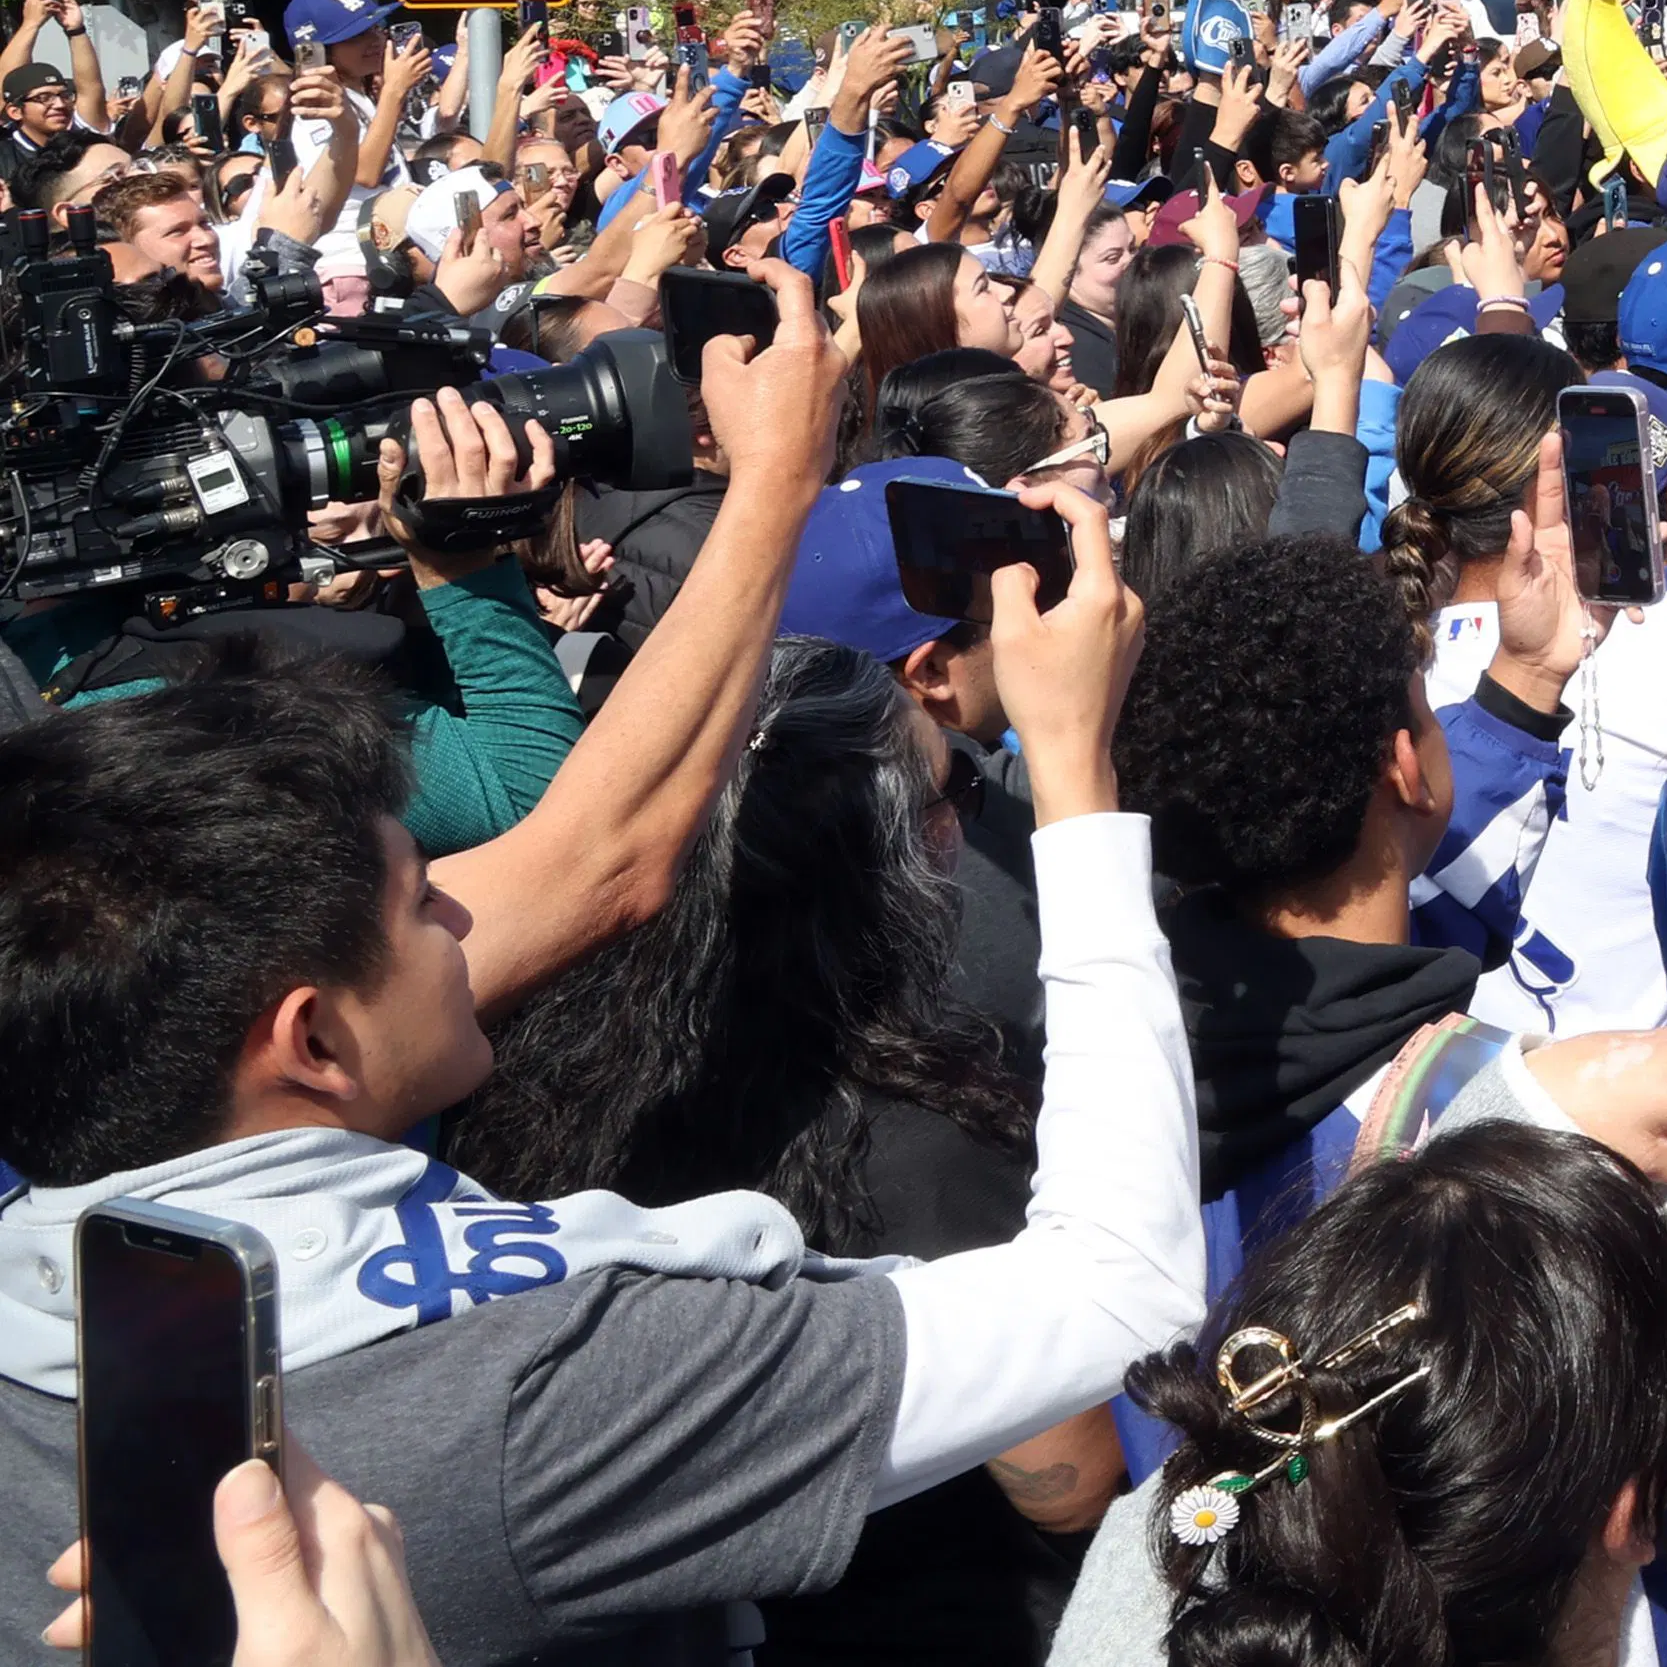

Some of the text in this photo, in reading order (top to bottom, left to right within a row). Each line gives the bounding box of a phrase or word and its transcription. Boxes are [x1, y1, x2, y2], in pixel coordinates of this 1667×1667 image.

[559, 421, 593, 435] 20-120
[568, 433, 584, 441] 4K
[464, 502, 533, 521] FUJINON
